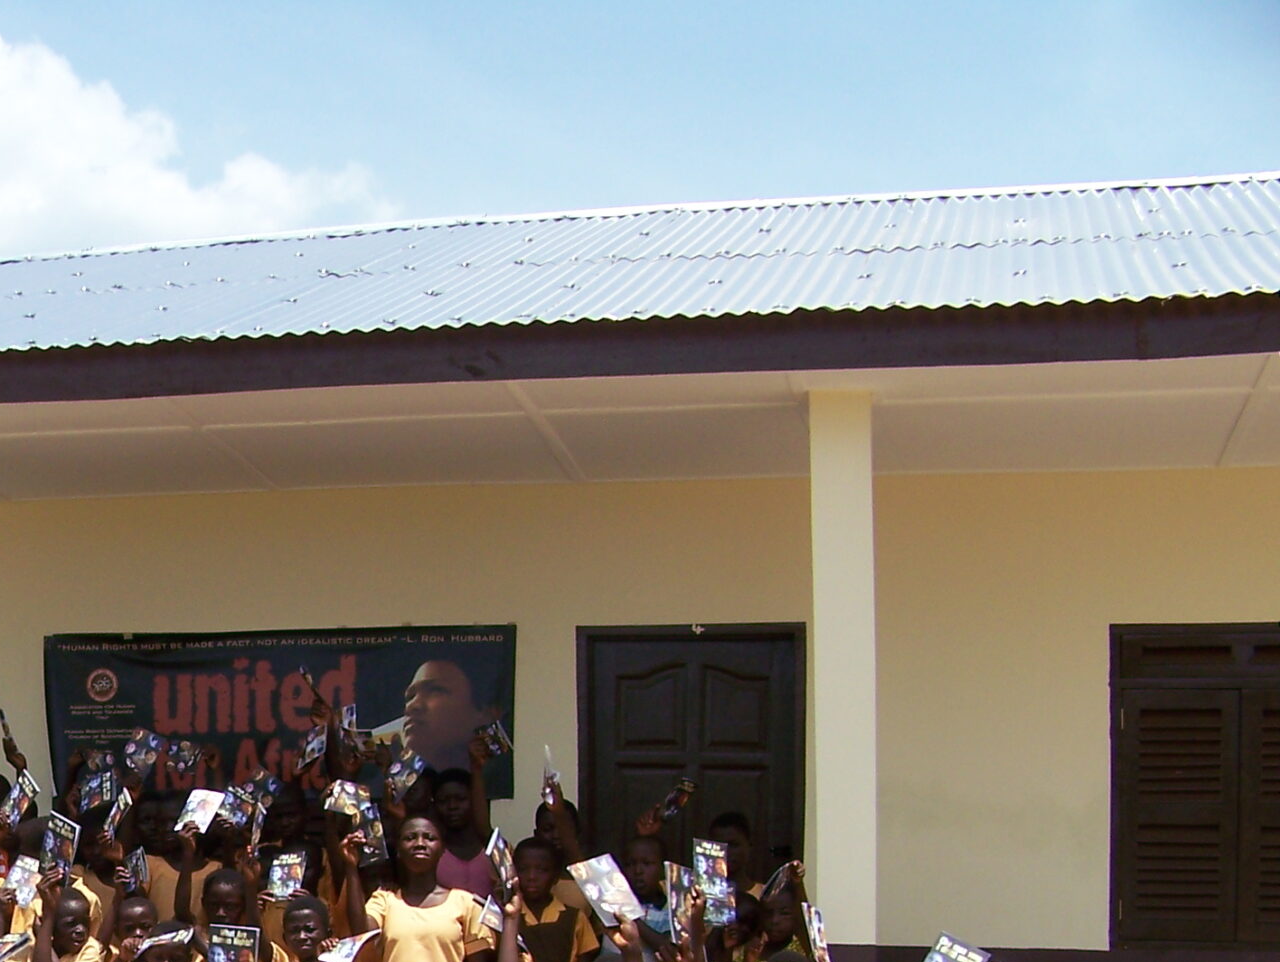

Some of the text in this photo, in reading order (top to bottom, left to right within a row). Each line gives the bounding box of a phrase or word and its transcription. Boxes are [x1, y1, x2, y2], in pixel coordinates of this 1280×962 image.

[102, 643, 138, 651] RIGHTS
[297, 637, 353, 645] IDEALISTIC
[421, 634, 445, 643] RON
[451, 634, 504, 643] HUBBARD
[152, 654, 357, 736] united
